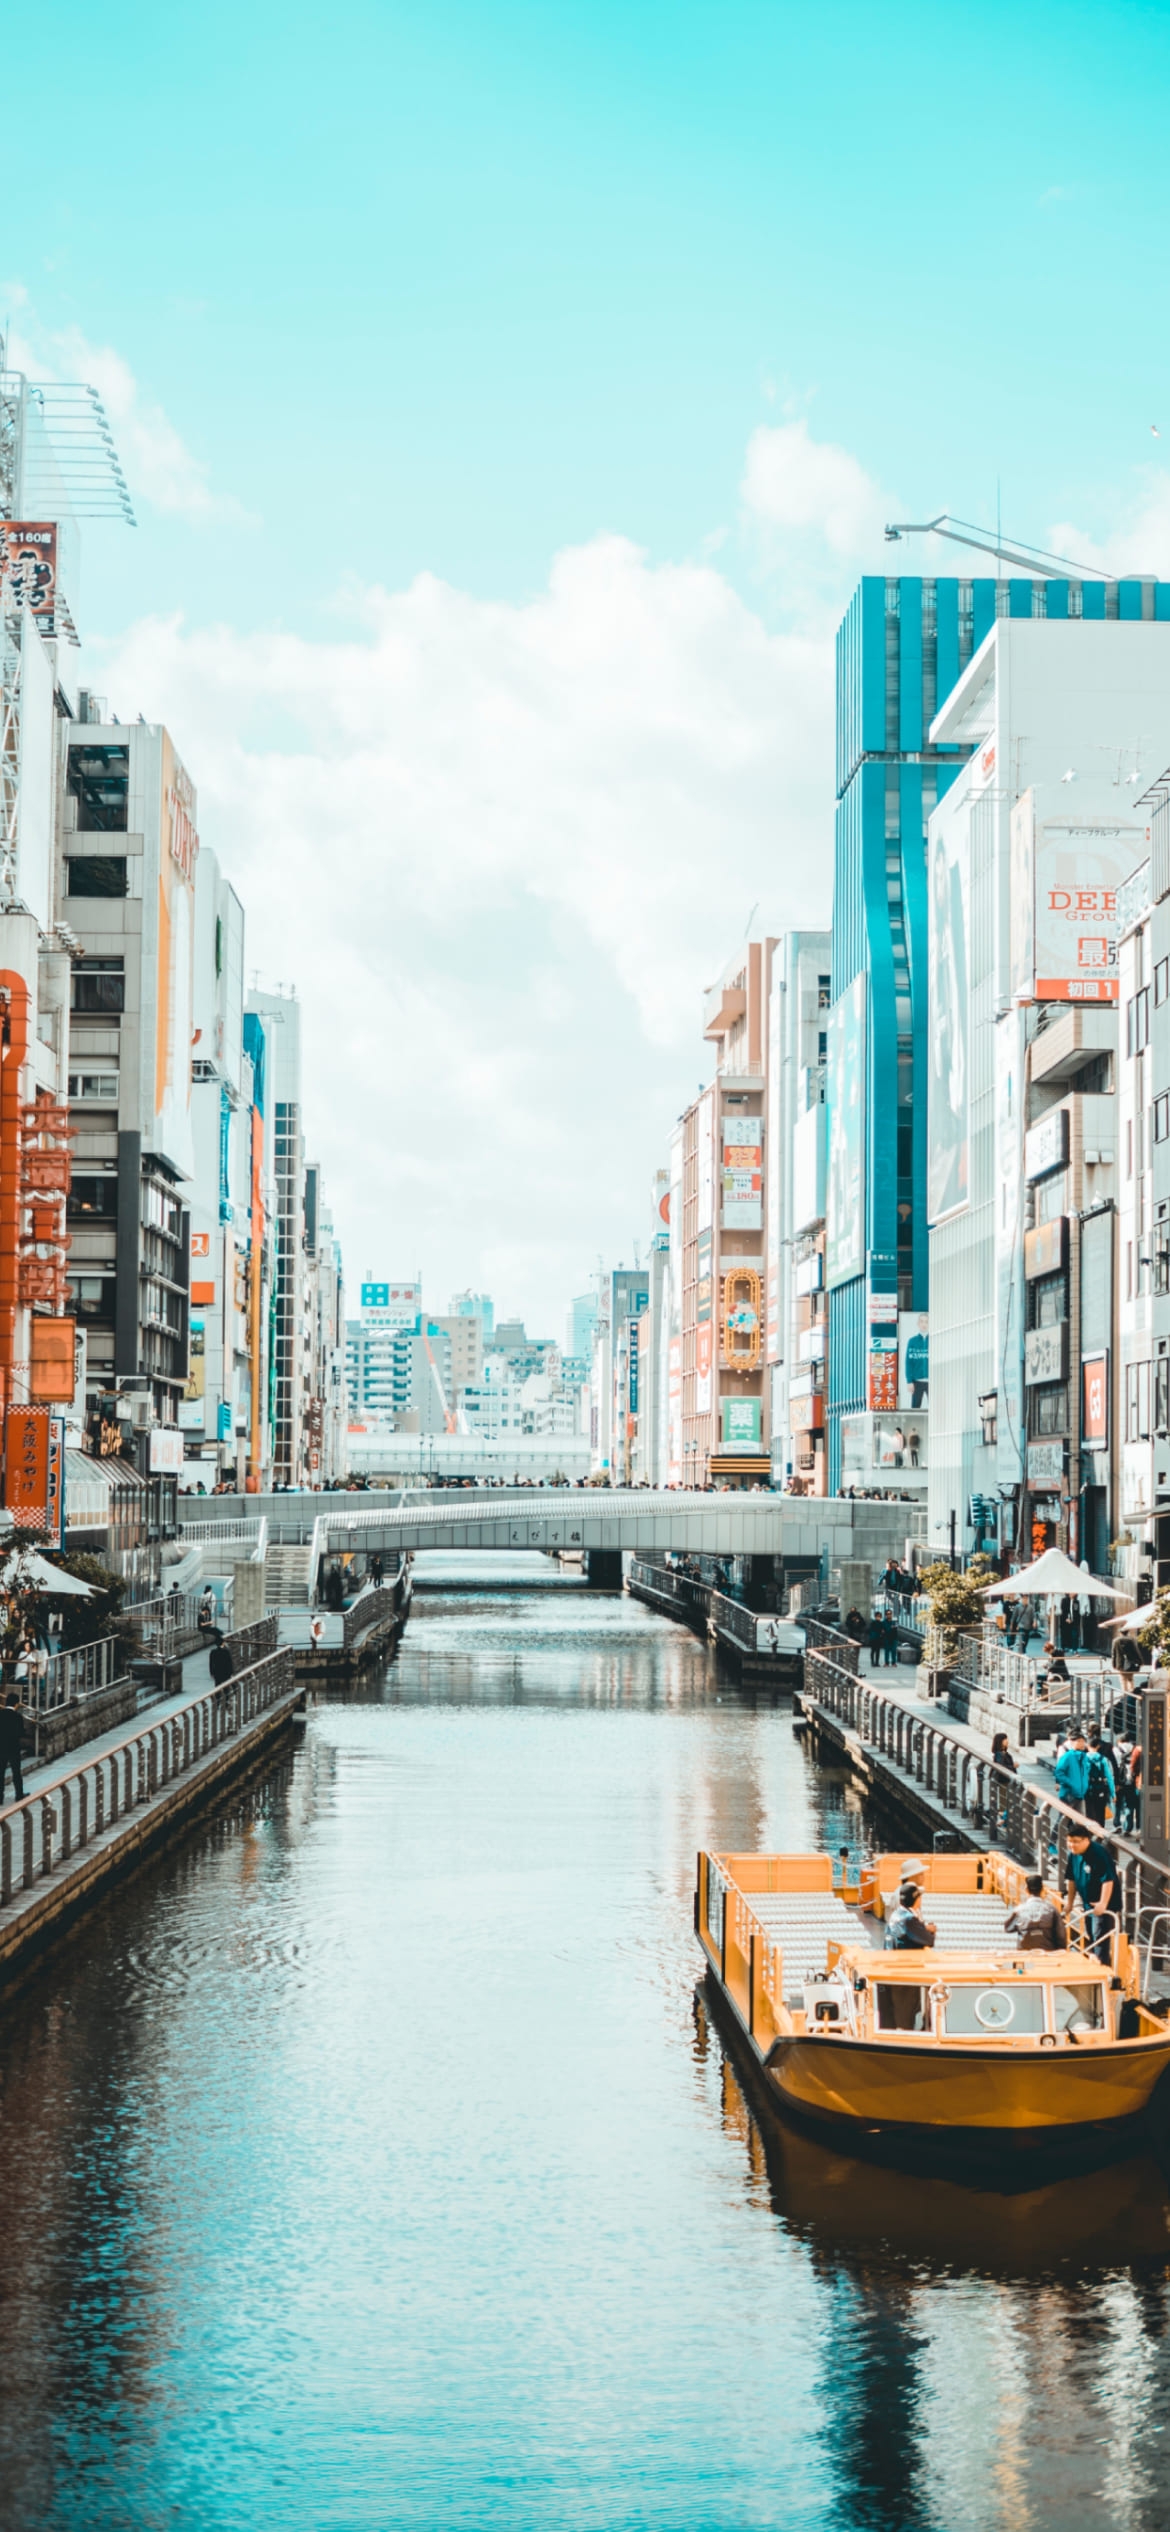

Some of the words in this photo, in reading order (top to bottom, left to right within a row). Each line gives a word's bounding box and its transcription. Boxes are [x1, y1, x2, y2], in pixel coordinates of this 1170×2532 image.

[873, 1374, 884, 1404] コミック
[885, 1352, 896, 1404] インターネット
[22, 1417, 38, 1494] 大阪みやげ
